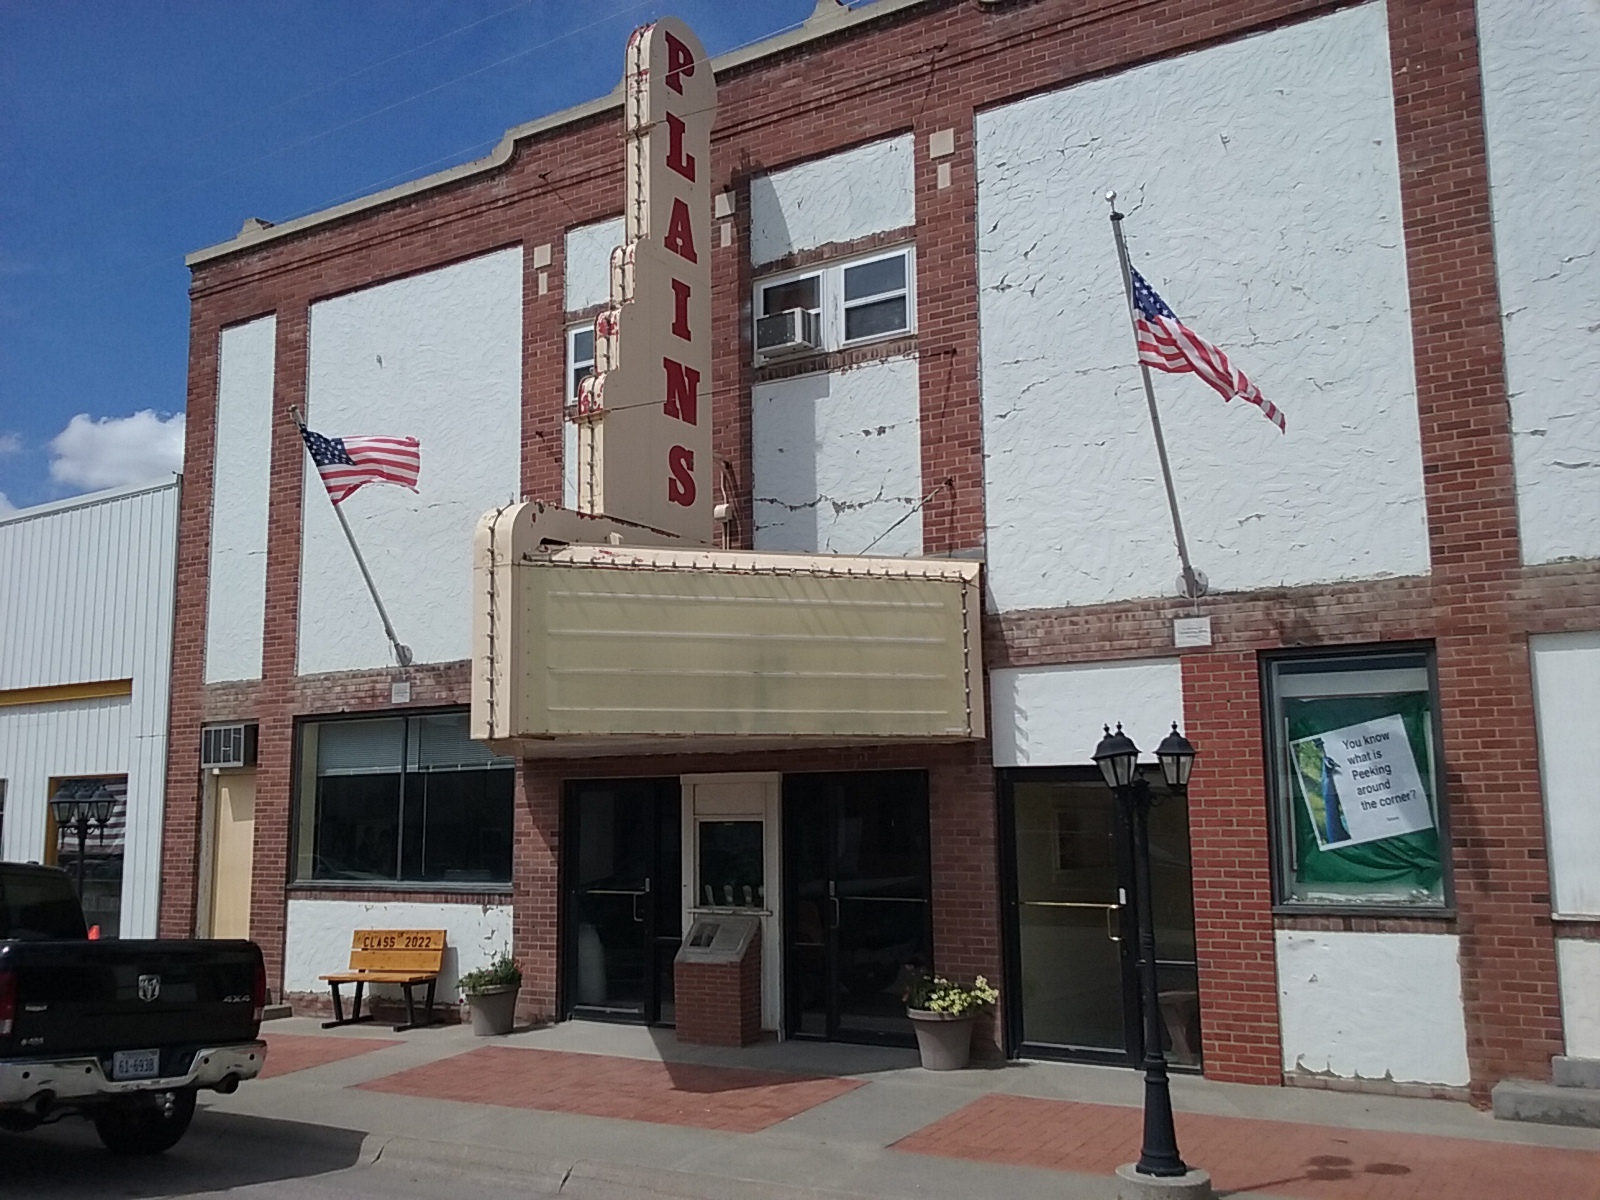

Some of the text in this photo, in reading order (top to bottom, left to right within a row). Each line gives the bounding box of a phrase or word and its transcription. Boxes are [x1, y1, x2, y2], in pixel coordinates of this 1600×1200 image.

[662, 30, 700, 508] PLAINS
[1342, 732, 1390, 750] You know
[1347, 749, 1383, 765] what is
[1351, 765, 1392, 780] Peeking
[1357, 778, 1391, 795] around
[1361, 789, 1417, 811] the corner?
[363, 936, 396, 948] CLASS
[404, 936, 432, 948] 2022
